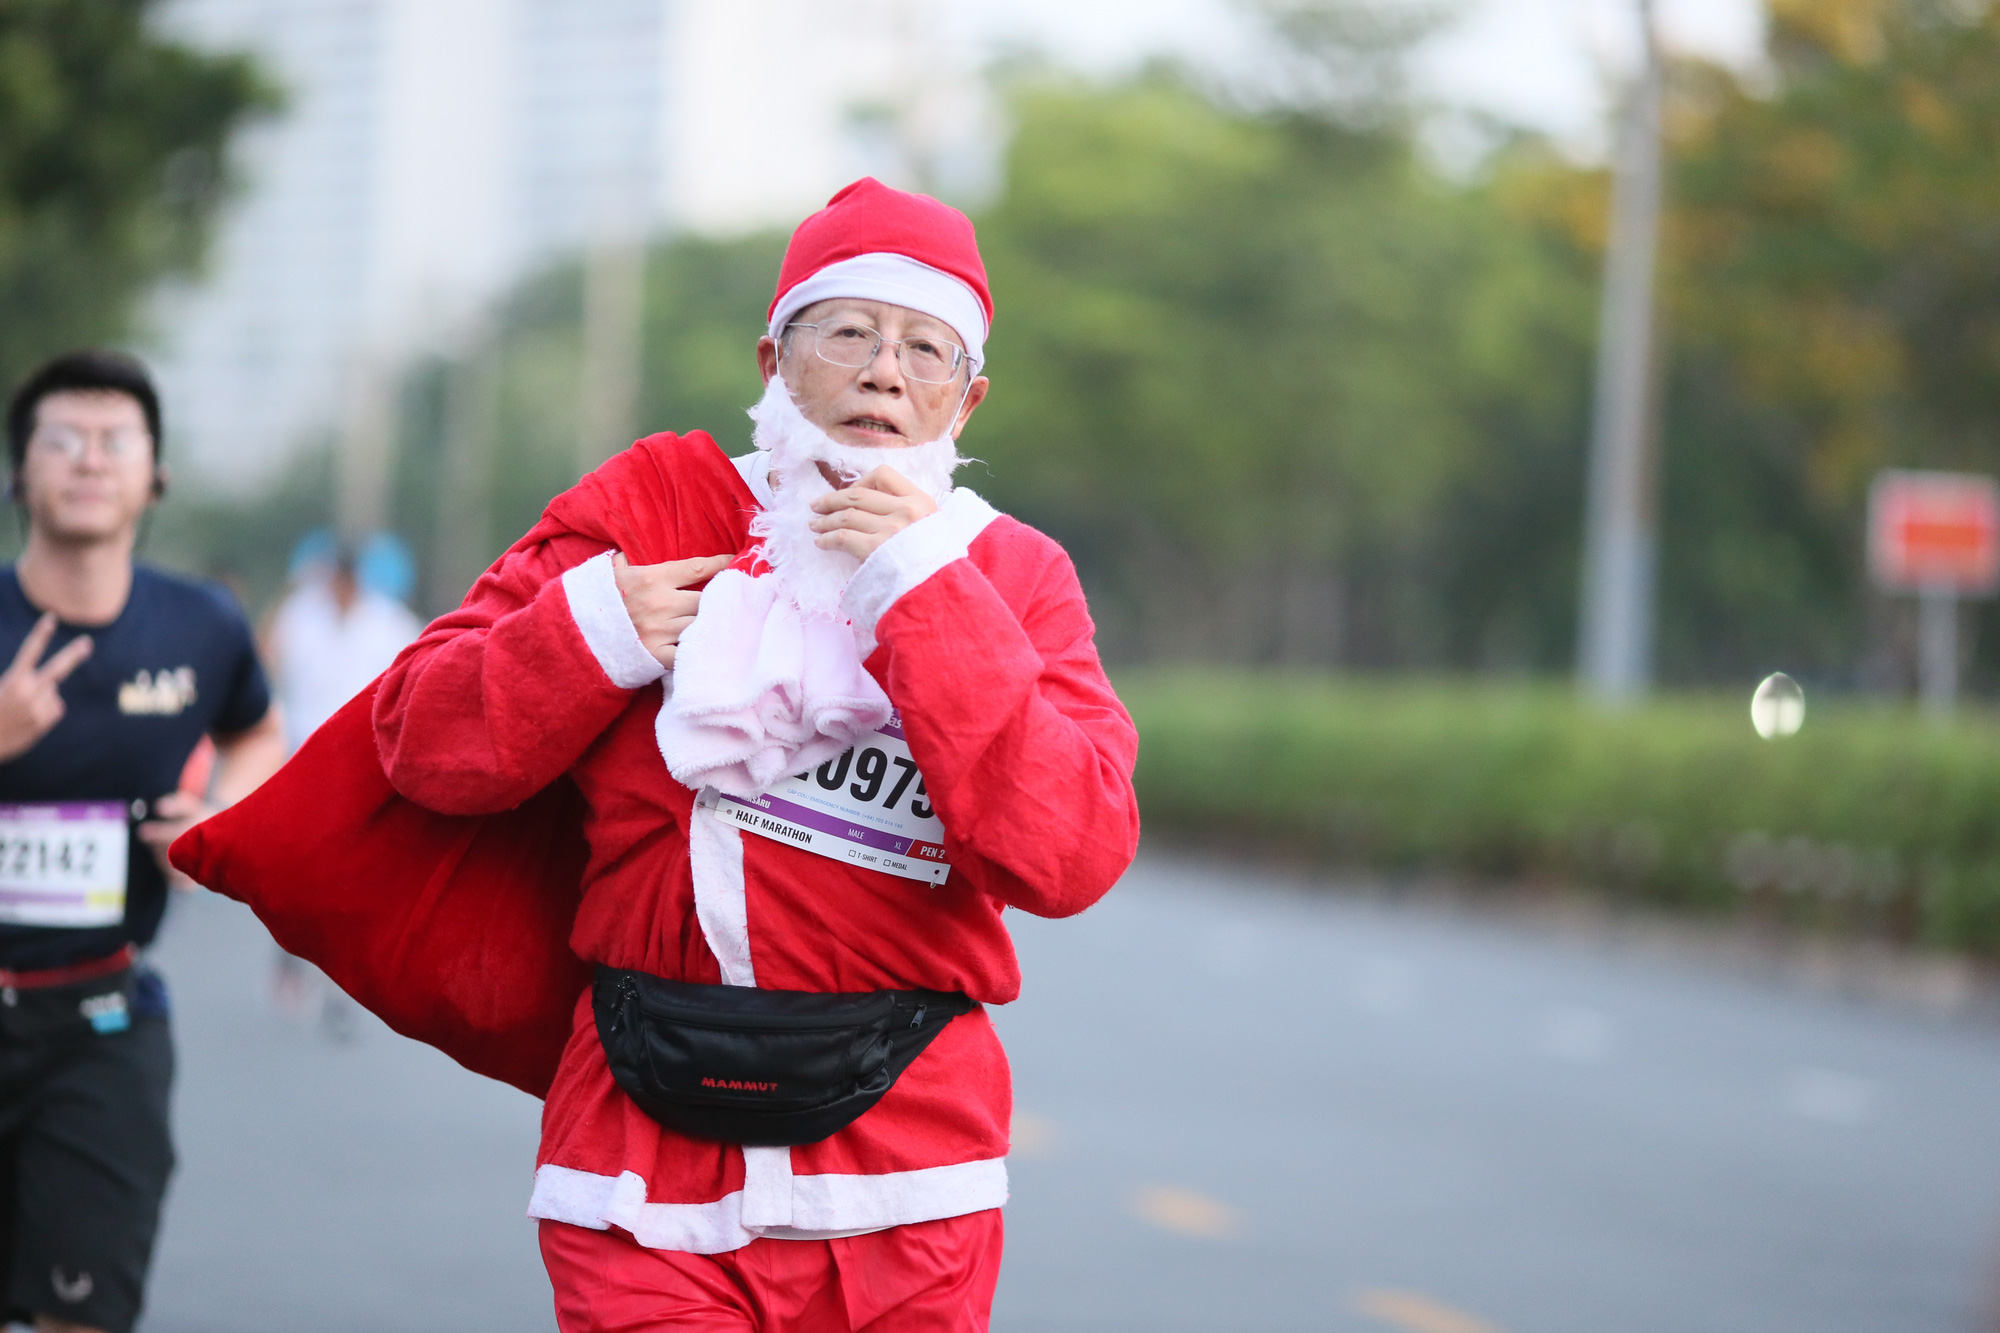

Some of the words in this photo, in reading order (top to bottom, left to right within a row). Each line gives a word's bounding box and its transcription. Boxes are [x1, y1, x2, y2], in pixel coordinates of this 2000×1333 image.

[810, 796, 839, 809] EMERGENCY
[735, 809, 760, 826] HALF
[760, 818, 813, 844] MARATHON
[848, 828, 865, 840] MALE
[893, 841, 902, 851] XL
[920, 845, 938, 858] PEN
[938, 849, 946, 860] 2
[857, 852, 878, 863] T-SHIRT
[891, 861, 908, 871] MEDAL
[701, 1076, 779, 1092] MAMMUT
